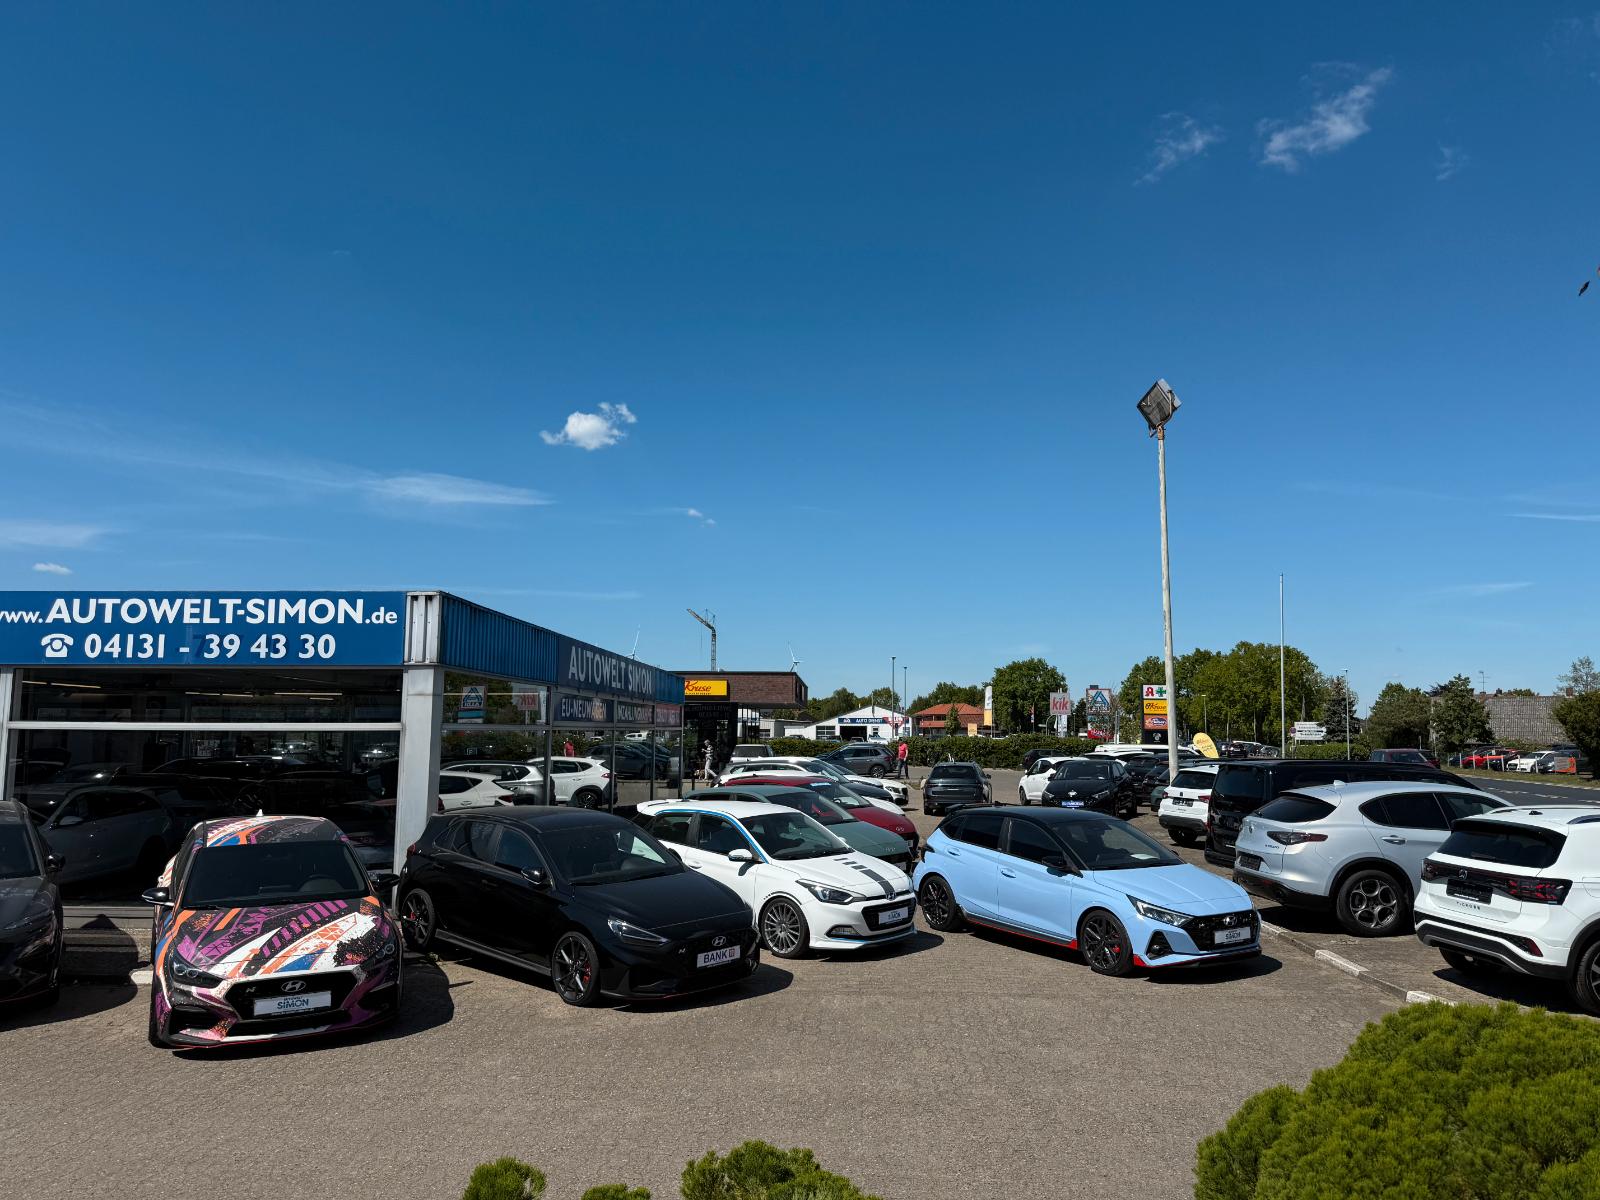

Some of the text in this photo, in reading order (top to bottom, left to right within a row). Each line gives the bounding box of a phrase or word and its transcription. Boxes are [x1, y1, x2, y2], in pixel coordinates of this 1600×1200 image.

[84, 633, 166, 659] 04131
[203, 633, 241, 659] 39
[250, 633, 287, 659] 43
[298, 633, 336, 659] 30
[568, 646, 652, 694] AUTOWELT SIMON
[703, 951, 728, 963] BANK
[277, 998, 309, 1010] SIMON
